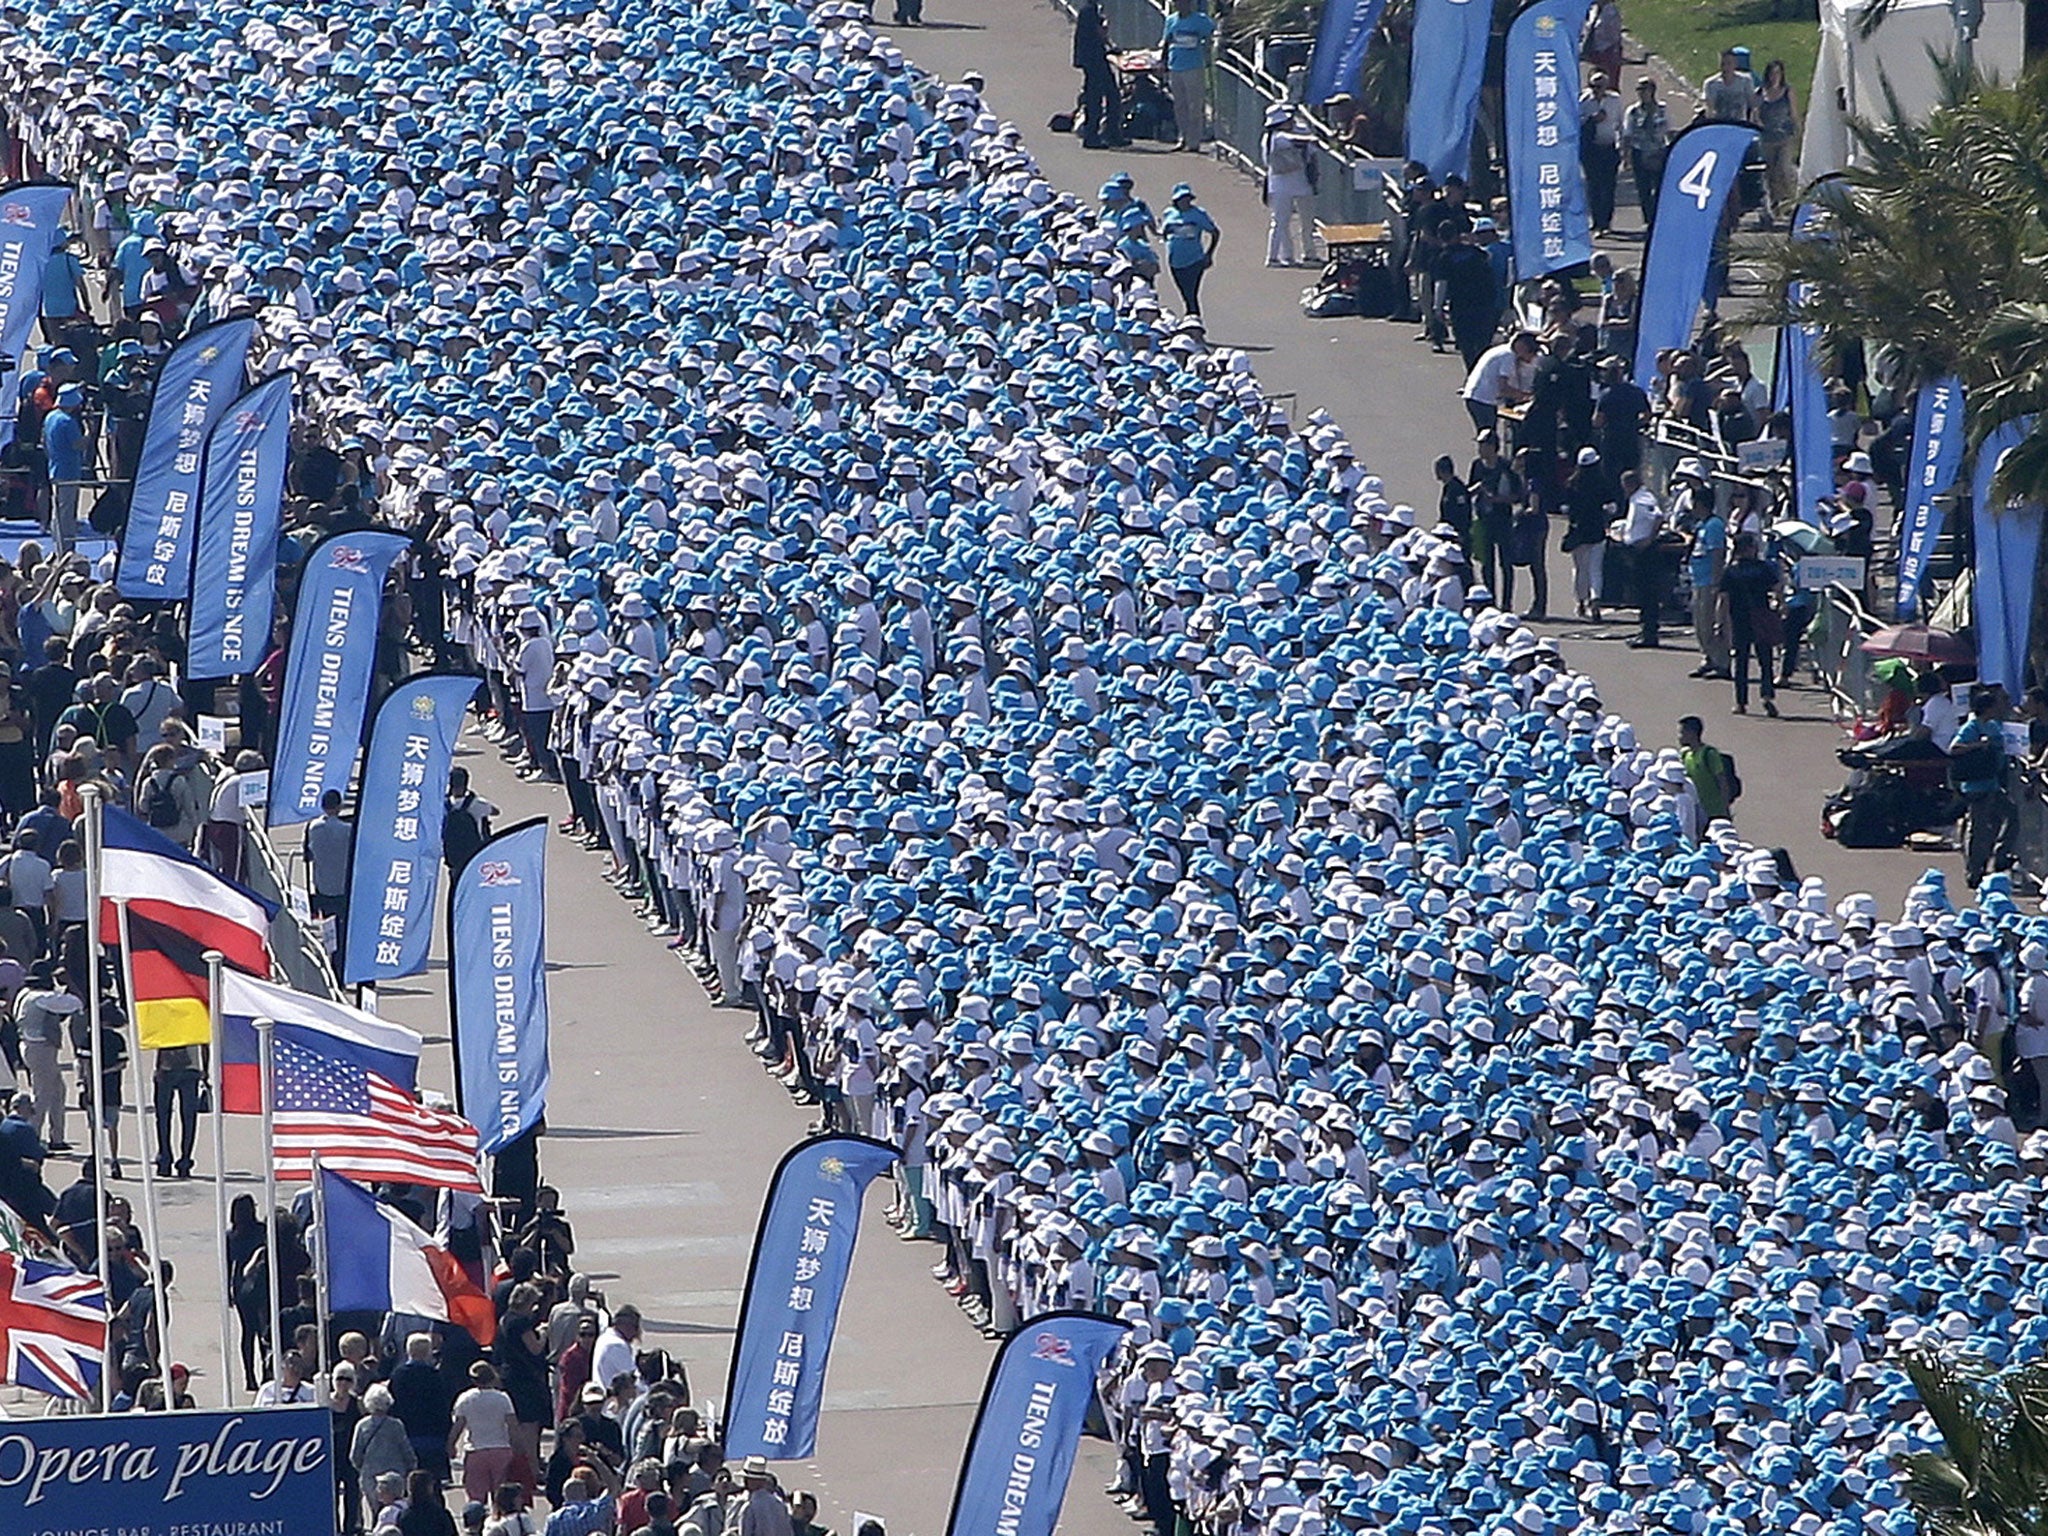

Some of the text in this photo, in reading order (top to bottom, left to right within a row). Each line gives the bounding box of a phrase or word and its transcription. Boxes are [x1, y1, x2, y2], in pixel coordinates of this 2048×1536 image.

[1679, 151, 1717, 210] 4
[236, 446, 258, 507] TIENS
[227, 511, 254, 584] DREAM
[225, 587, 244, 610] IS
[325, 586, 354, 648] TIENS
[313, 652, 342, 728] DREAM
[308, 733, 332, 756] IS
[298, 759, 327, 809] NICE
[394, 735, 430, 841] 天狮梦想
[375, 860, 412, 967] 尼斯绽放
[491, 902, 513, 968] TIENS
[493, 975, 518, 1055] DREAM
[498, 1061, 519, 1083] IS
[788, 1197, 836, 1312] 天狮梦想
[762, 1331, 806, 1446] 尼斯绽放
[1019, 1381, 1058, 1449] TIENS
[0, 1417, 327, 1508] Opera plage
[996, 1453, 1036, 1536] DREAM
[170, 1519, 285, 1536] RESTAURANT
